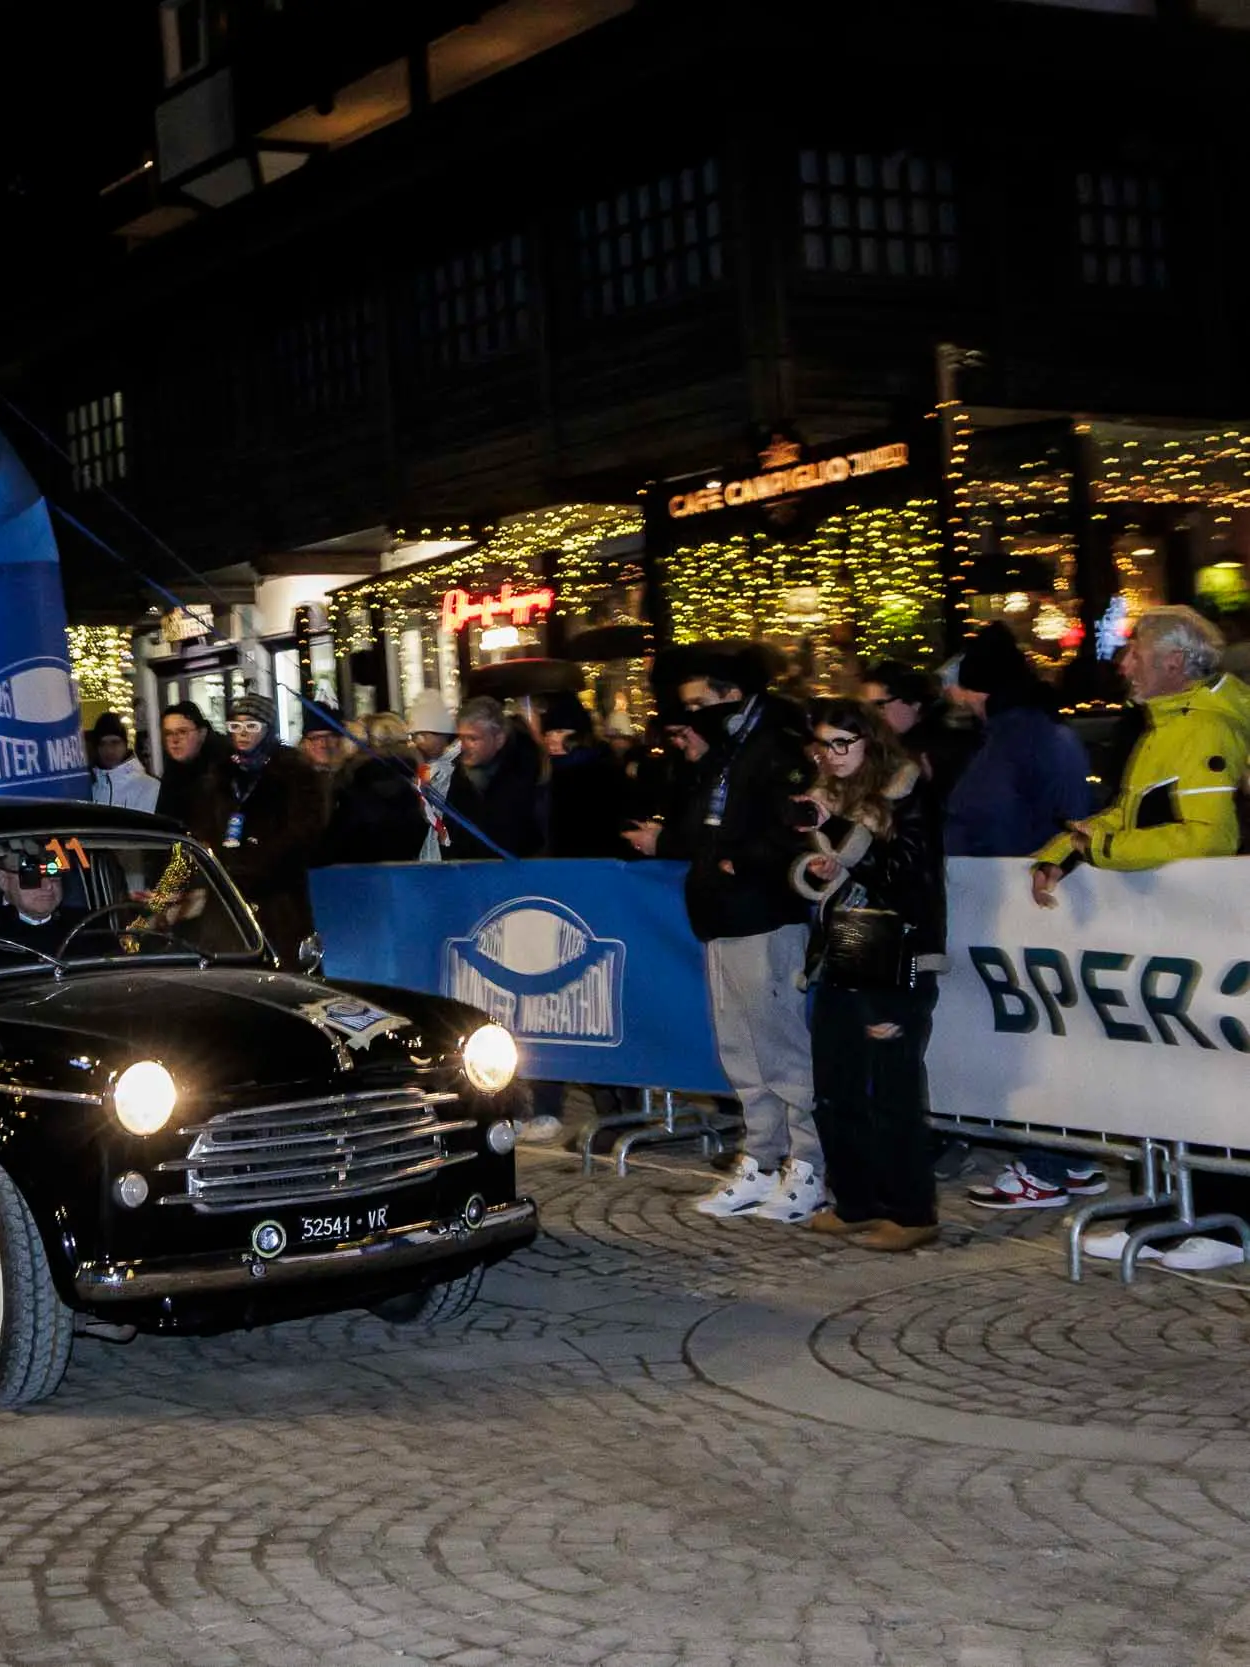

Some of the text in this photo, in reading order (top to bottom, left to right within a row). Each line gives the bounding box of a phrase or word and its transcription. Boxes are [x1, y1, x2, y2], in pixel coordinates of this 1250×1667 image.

[519, 950, 615, 1036] MARATHON
[303, 1207, 388, 1239] 52541 VR
